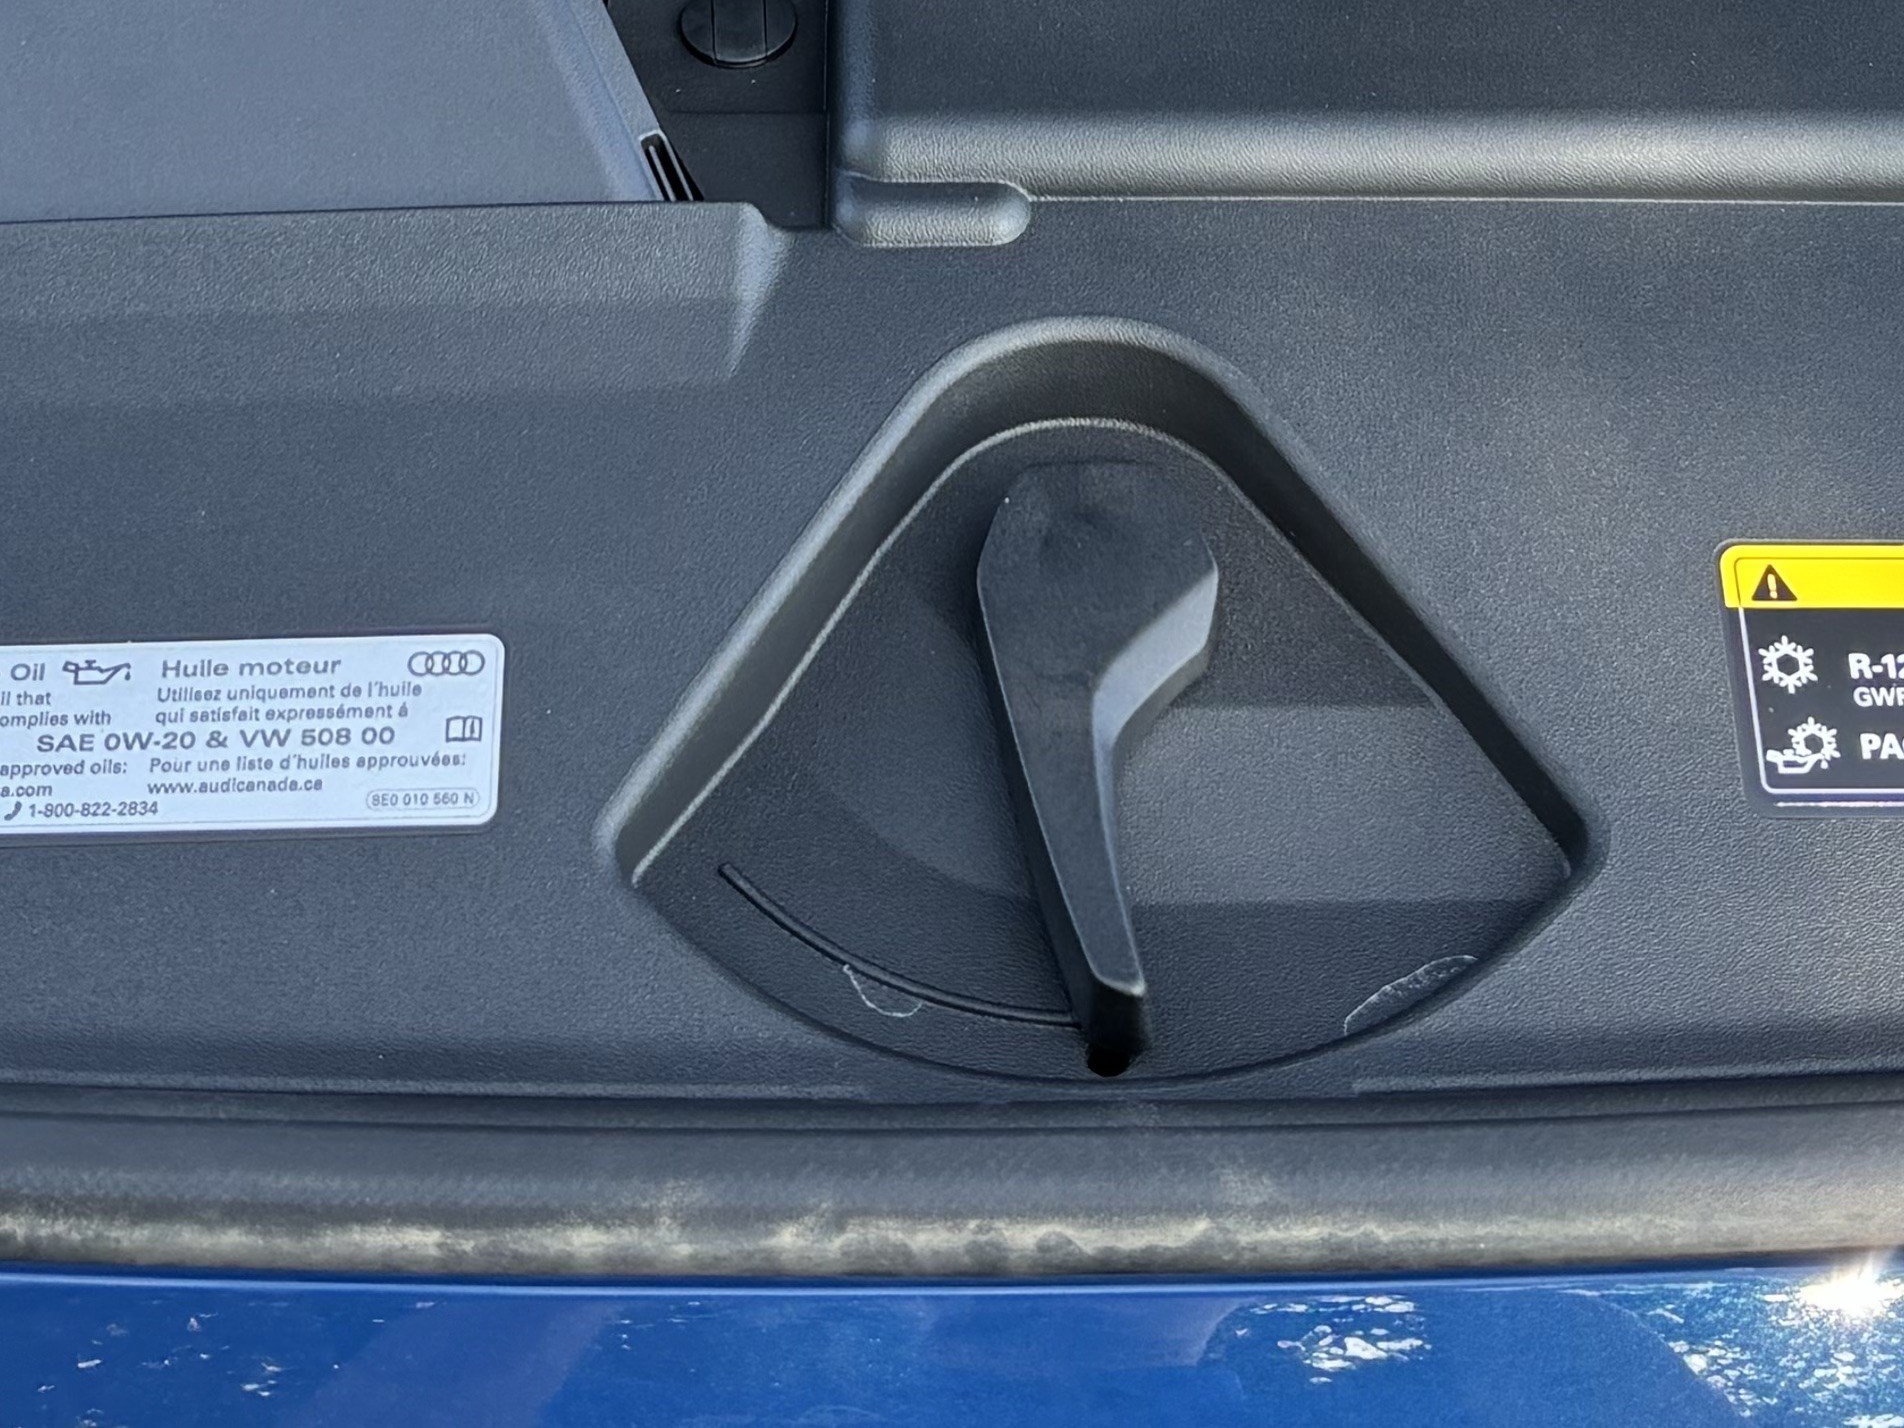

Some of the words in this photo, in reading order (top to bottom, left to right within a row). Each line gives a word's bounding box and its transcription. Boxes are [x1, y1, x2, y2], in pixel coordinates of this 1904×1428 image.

[10, 662, 46, 682] Oil
[161, 658, 230, 679] Huile
[238, 658, 342, 677] moteur
[16, 690, 52, 706] that
[157, 686, 222, 703] Utilisez
[226, 684, 335, 703] uniquement
[340, 682, 362, 698] de
[73, 710, 112, 726] with
[155, 707, 185, 727] qui
[189, 705, 260, 723] satisfait
[265, 703, 393, 723] expressément
[36, 733, 95, 753] SAE
[104, 730, 196, 752] 0W-20
[205, 730, 228, 749] &
[239, 728, 292, 748] VW
[301, 727, 351, 747] 508
[361, 726, 395, 745] 00
[0, 759, 86, 780] approved
[89, 758, 127, 775] oils:
[149, 757, 192, 773] Pour
[197, 759, 231, 772] une
[236, 755, 274, 772] liste
[147, 776, 323, 795] www.audicanada.ca
[28, 800, 159, 819] 1-800-822-2834
